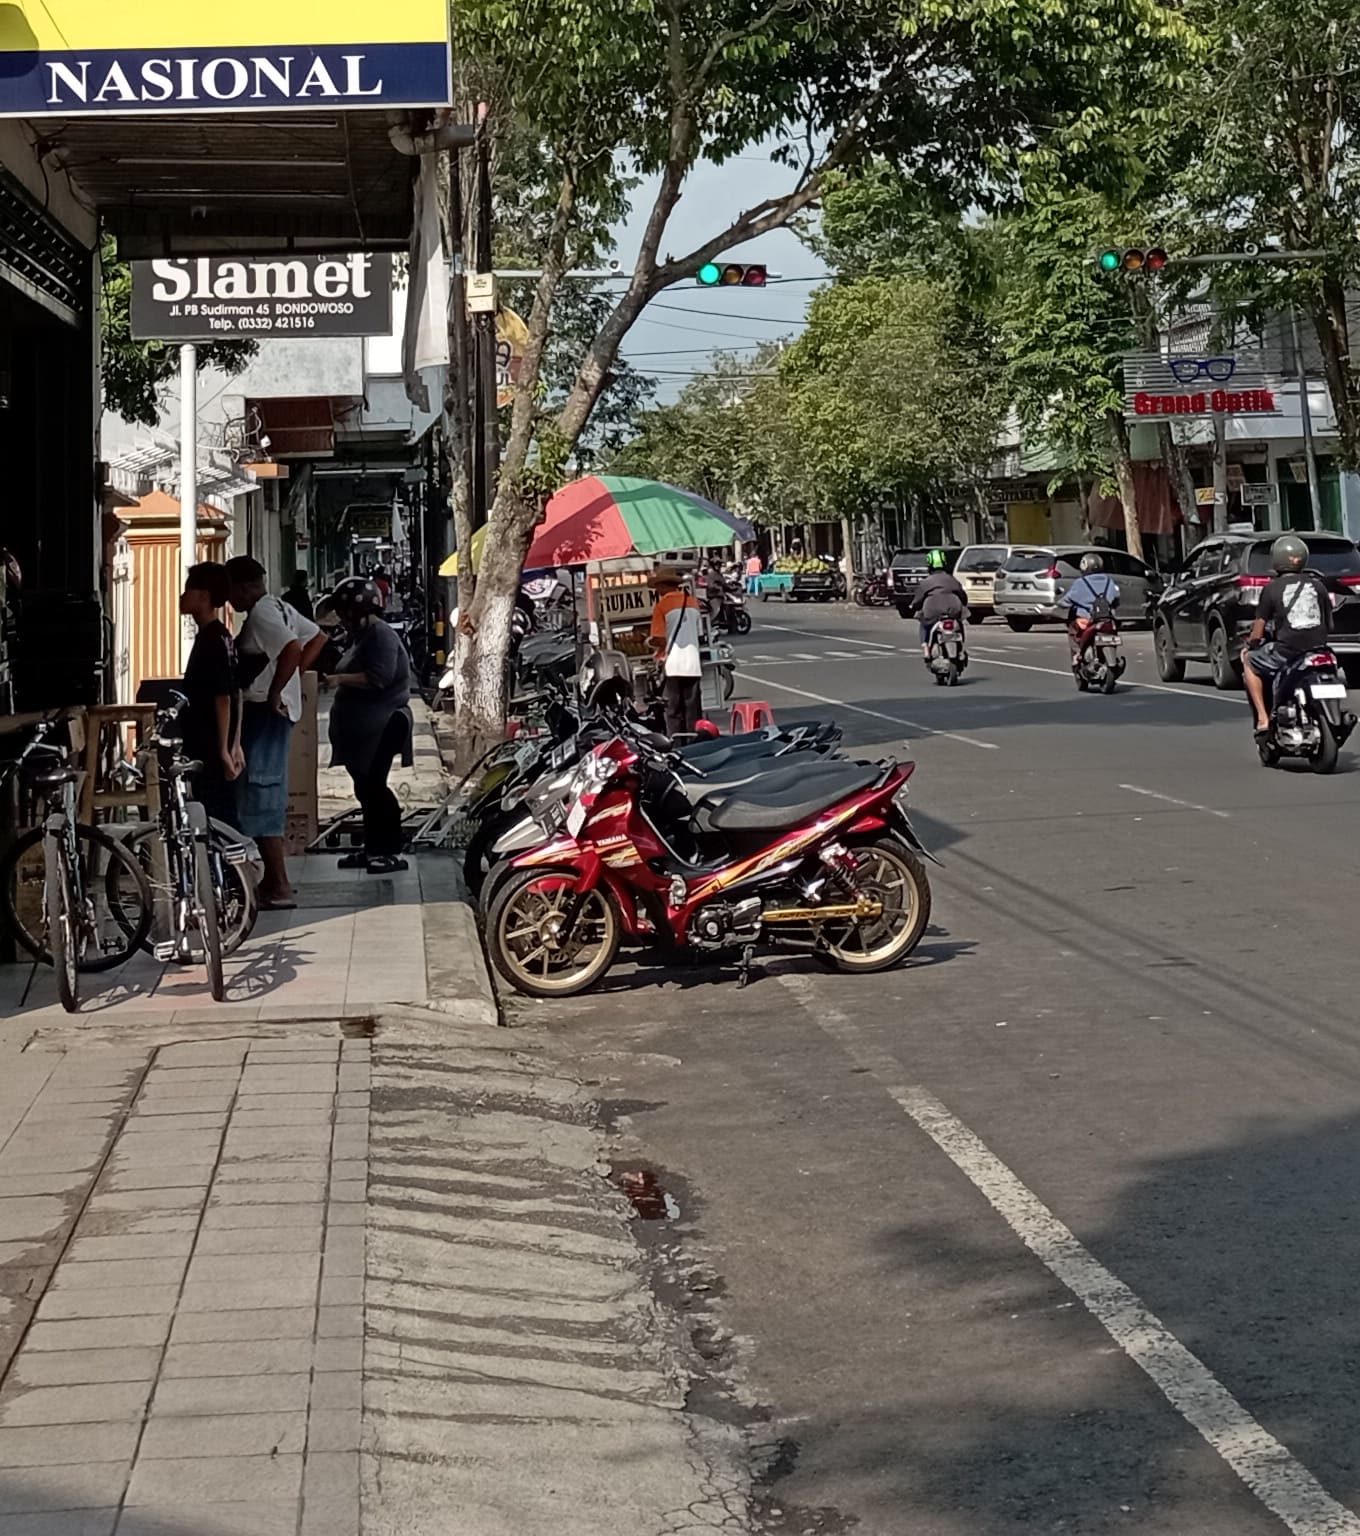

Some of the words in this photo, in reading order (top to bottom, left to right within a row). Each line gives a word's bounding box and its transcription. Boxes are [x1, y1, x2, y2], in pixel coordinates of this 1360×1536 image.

[45, 54, 383, 106] NASIONAL
[152, 252, 372, 302] Slamet
[185, 305, 198, 315] PB
[201, 303, 253, 315] Sudirman
[256, 303, 270, 314] 45
[275, 302, 354, 314] BONDOWOSO
[209, 317, 235, 330] Telp.
[238, 317, 272, 330] (0332)
[275, 317, 315, 329] 421516
[1134, 391, 1206, 414] Grand
[1211, 389, 1275, 412] Optik
[600, 590, 645, 613] RUJAK
